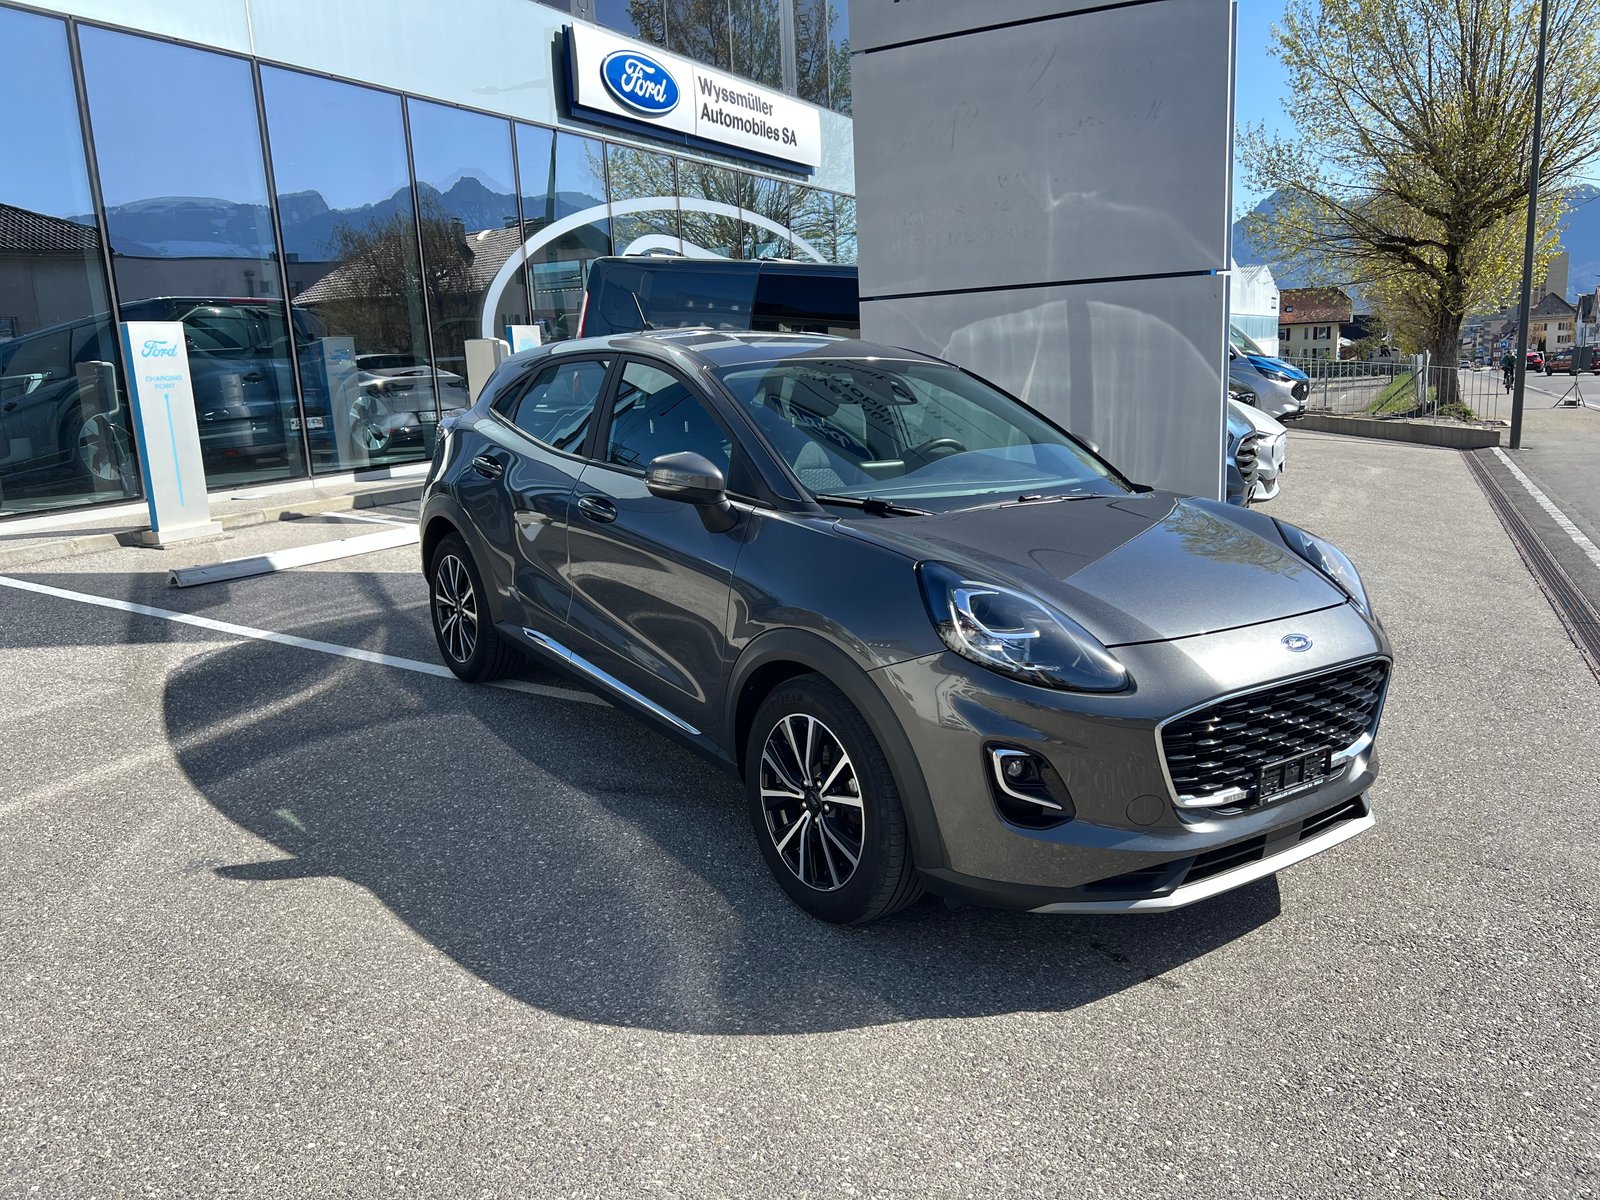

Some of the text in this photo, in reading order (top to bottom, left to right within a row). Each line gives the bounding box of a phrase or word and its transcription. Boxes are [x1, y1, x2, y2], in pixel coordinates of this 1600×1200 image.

[621, 58, 667, 103] Ford
[697, 75, 774, 117] Wyssmüller
[700, 102, 798, 147] Automobiles SA
[141, 339, 178, 358] Ford
